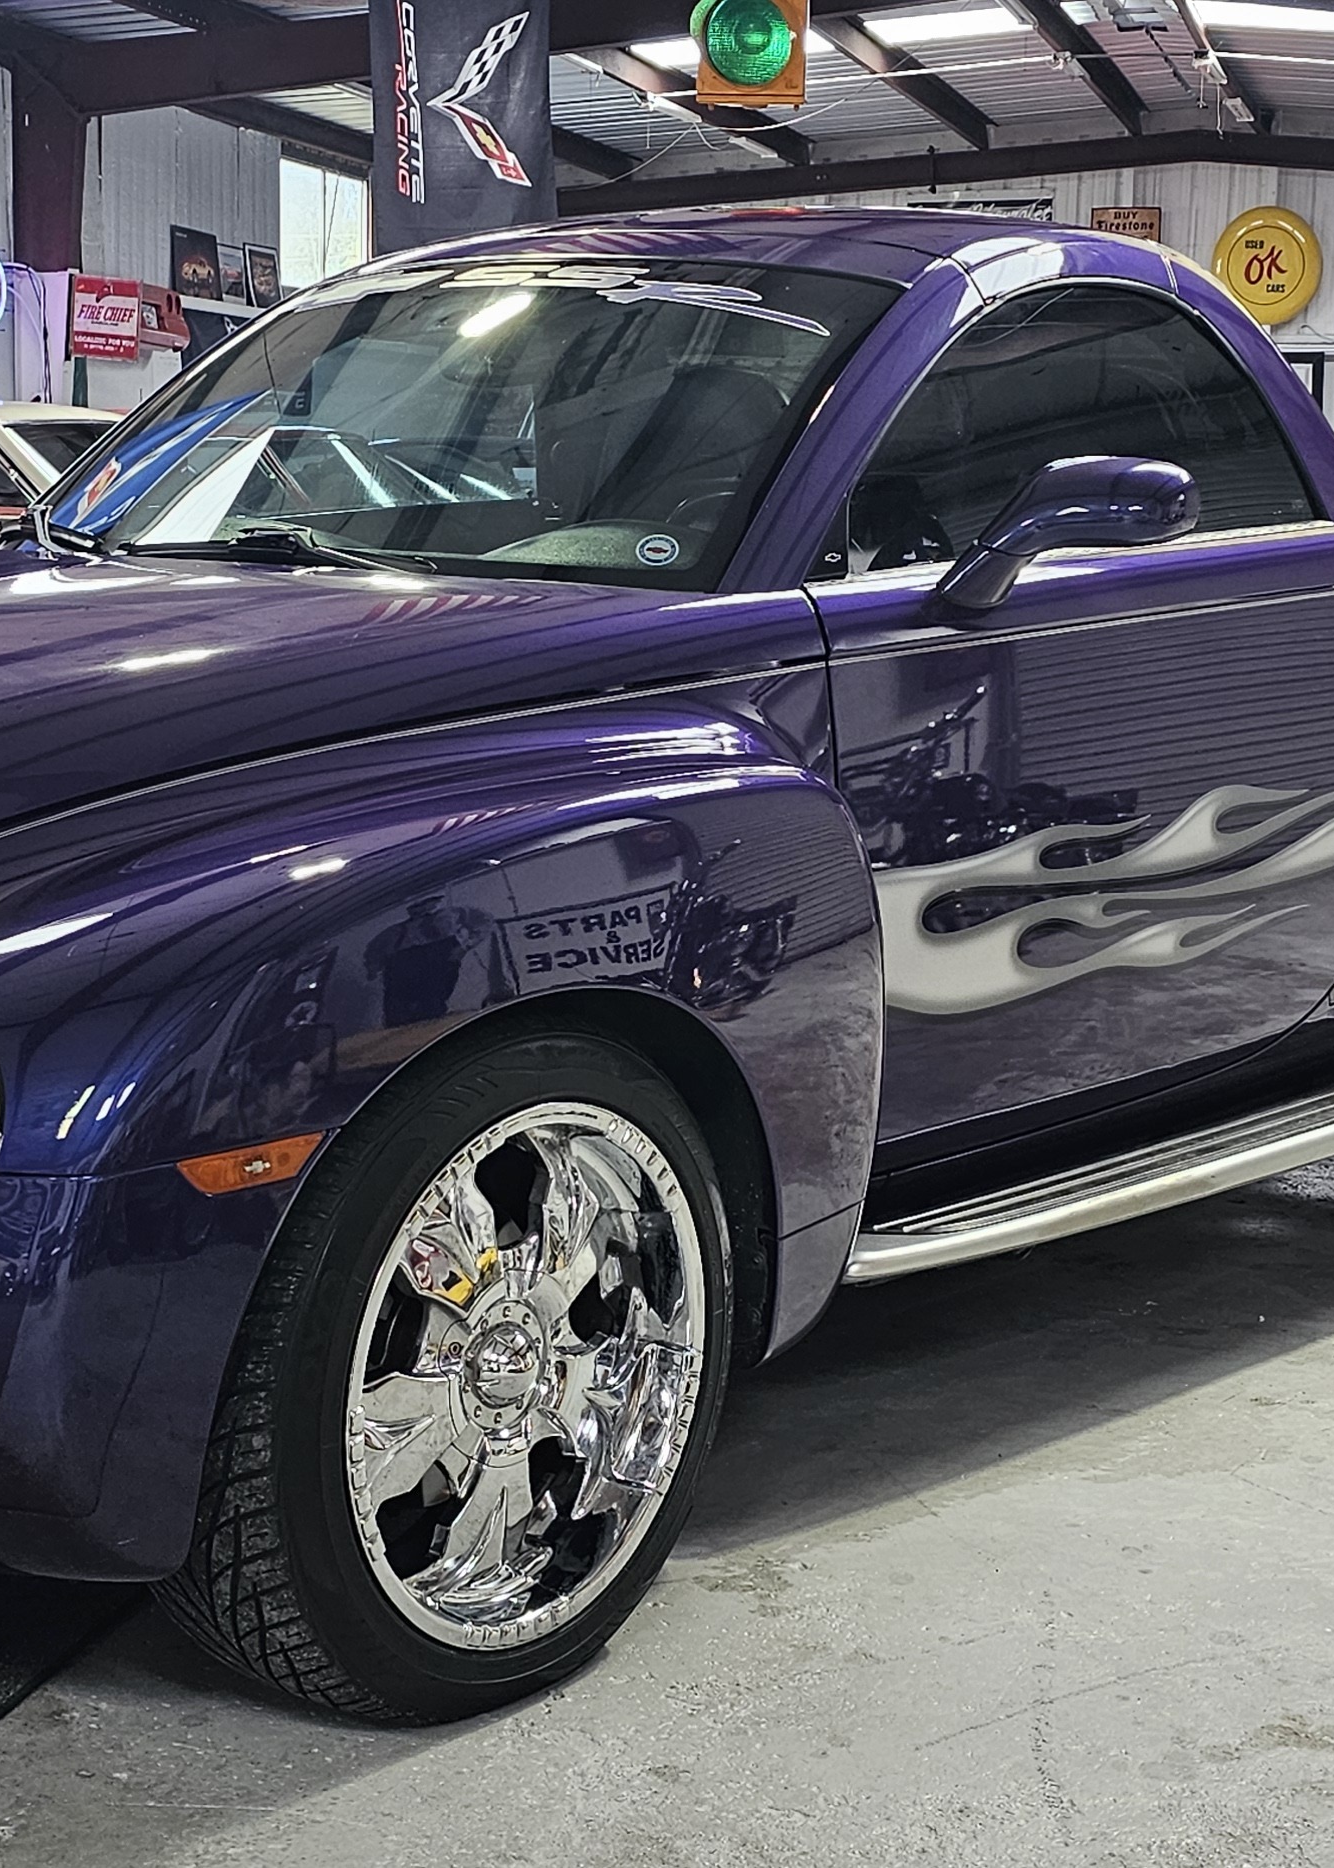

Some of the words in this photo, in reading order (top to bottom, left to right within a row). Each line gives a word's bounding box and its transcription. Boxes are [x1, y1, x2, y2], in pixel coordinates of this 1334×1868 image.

[402, 2, 425, 204] CORVETTE
[395, 64, 411, 196] RACING
[1114, 211, 1138, 220] BUY
[1096, 220, 1155, 231] Firestone
[1244, 240, 1265, 250] USED
[1244, 245, 1288, 285] OK
[1265, 284, 1286, 293] CARS
[77, 304, 102, 320] FIRE
[103, 306, 136, 323] CHIEF
